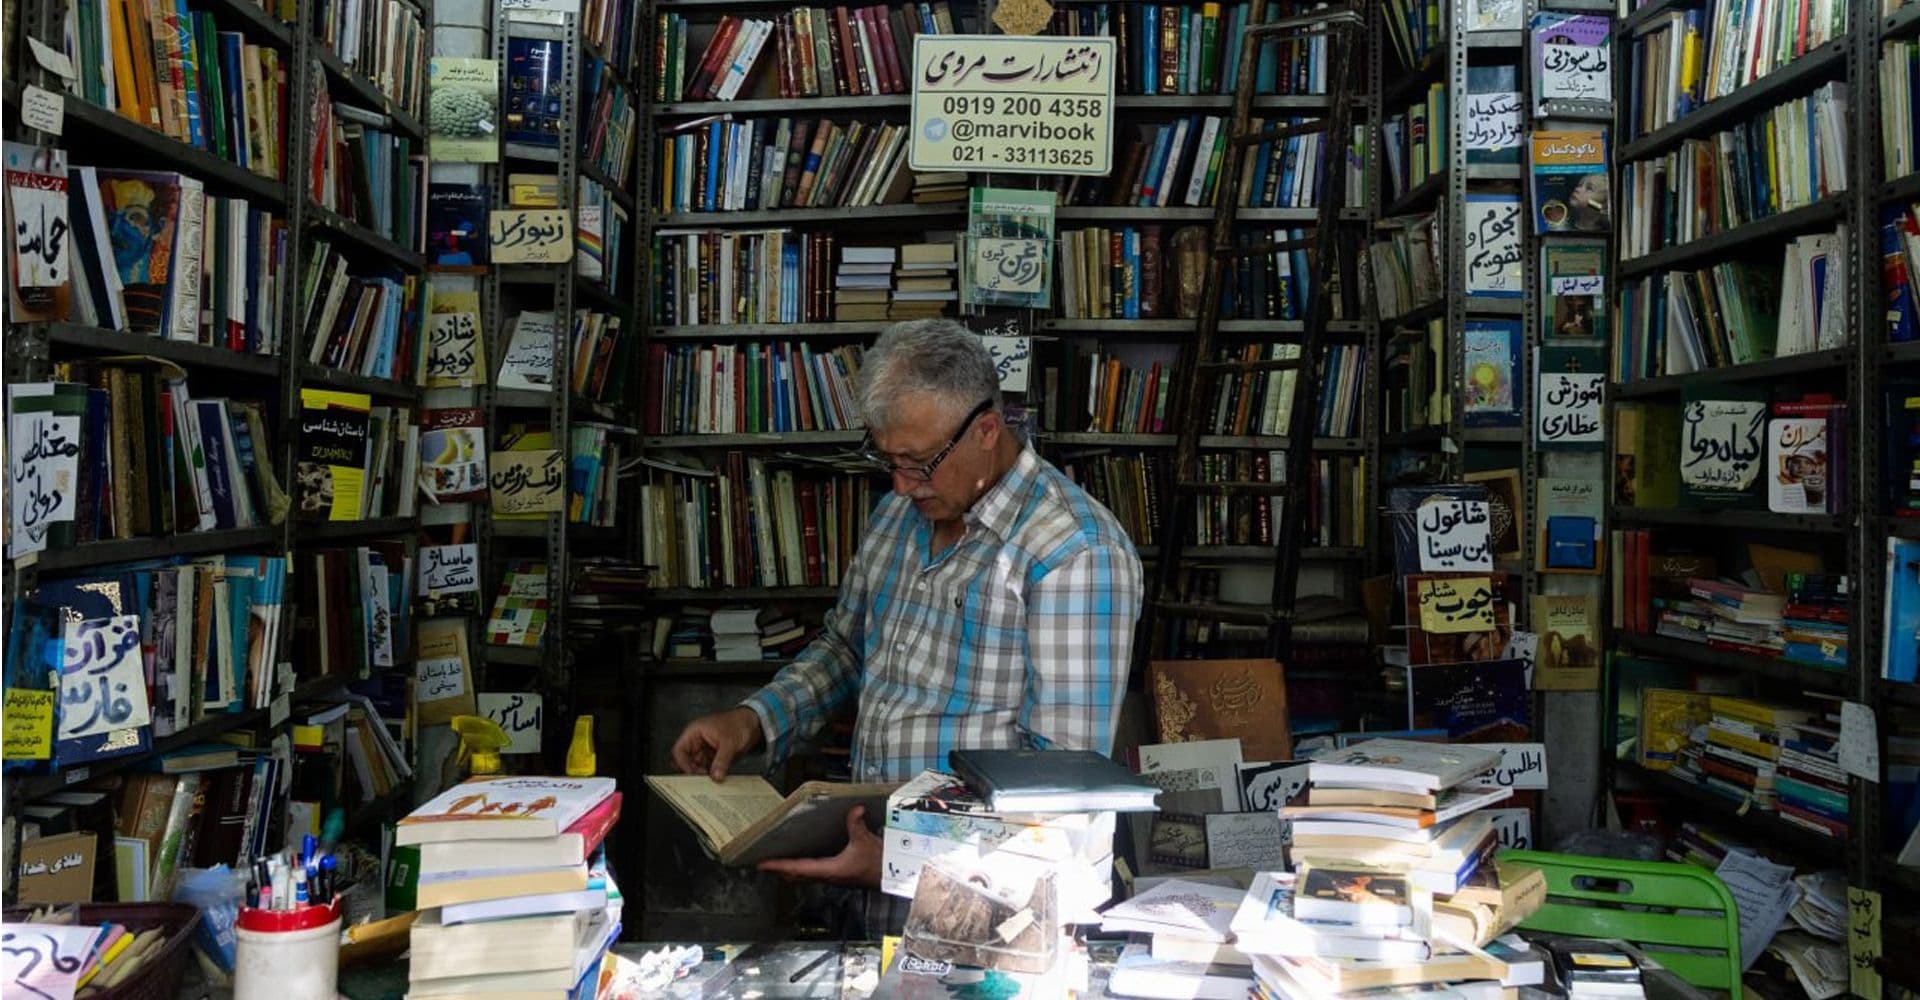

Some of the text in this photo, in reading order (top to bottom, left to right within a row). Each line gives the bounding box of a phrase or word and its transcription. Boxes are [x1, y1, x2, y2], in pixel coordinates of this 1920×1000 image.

[925, 46, 1103, 87] انتشارات مروی
[1545, 48, 1607, 80] طب سوزنی
[944, 96, 1101, 118] 0919 200 4358
[951, 119, 1095, 142] @marvibook
[952, 146, 984, 161] 021
[1004, 147, 1094, 165] 33113625
[18, 203, 67, 278] حجامت
[490, 213, 563, 248] زنبور عسل
[1480, 206, 1520, 249] نجوم
[998, 241, 1040, 285] روغن
[1469, 244, 1523, 283] تقویم
[1547, 376, 1605, 408] آموزش
[1542, 413, 1599, 439] عطاری
[1717, 409, 1768, 470] گیاه
[14, 419, 79, 482] مغناطیس
[526, 451, 564, 494] رنگ
[1423, 501, 1487, 535] شاغول
[424, 548, 473, 575] ماساژ
[1428, 533, 1492, 566] ابن سینا
[428, 566, 474, 589] سنگ
[1419, 580, 1494, 623] چوب شناسی
[62, 619, 139, 675] قرآن
[62, 676, 132, 734] فارس
[1496, 751, 1542, 786] اطلس
